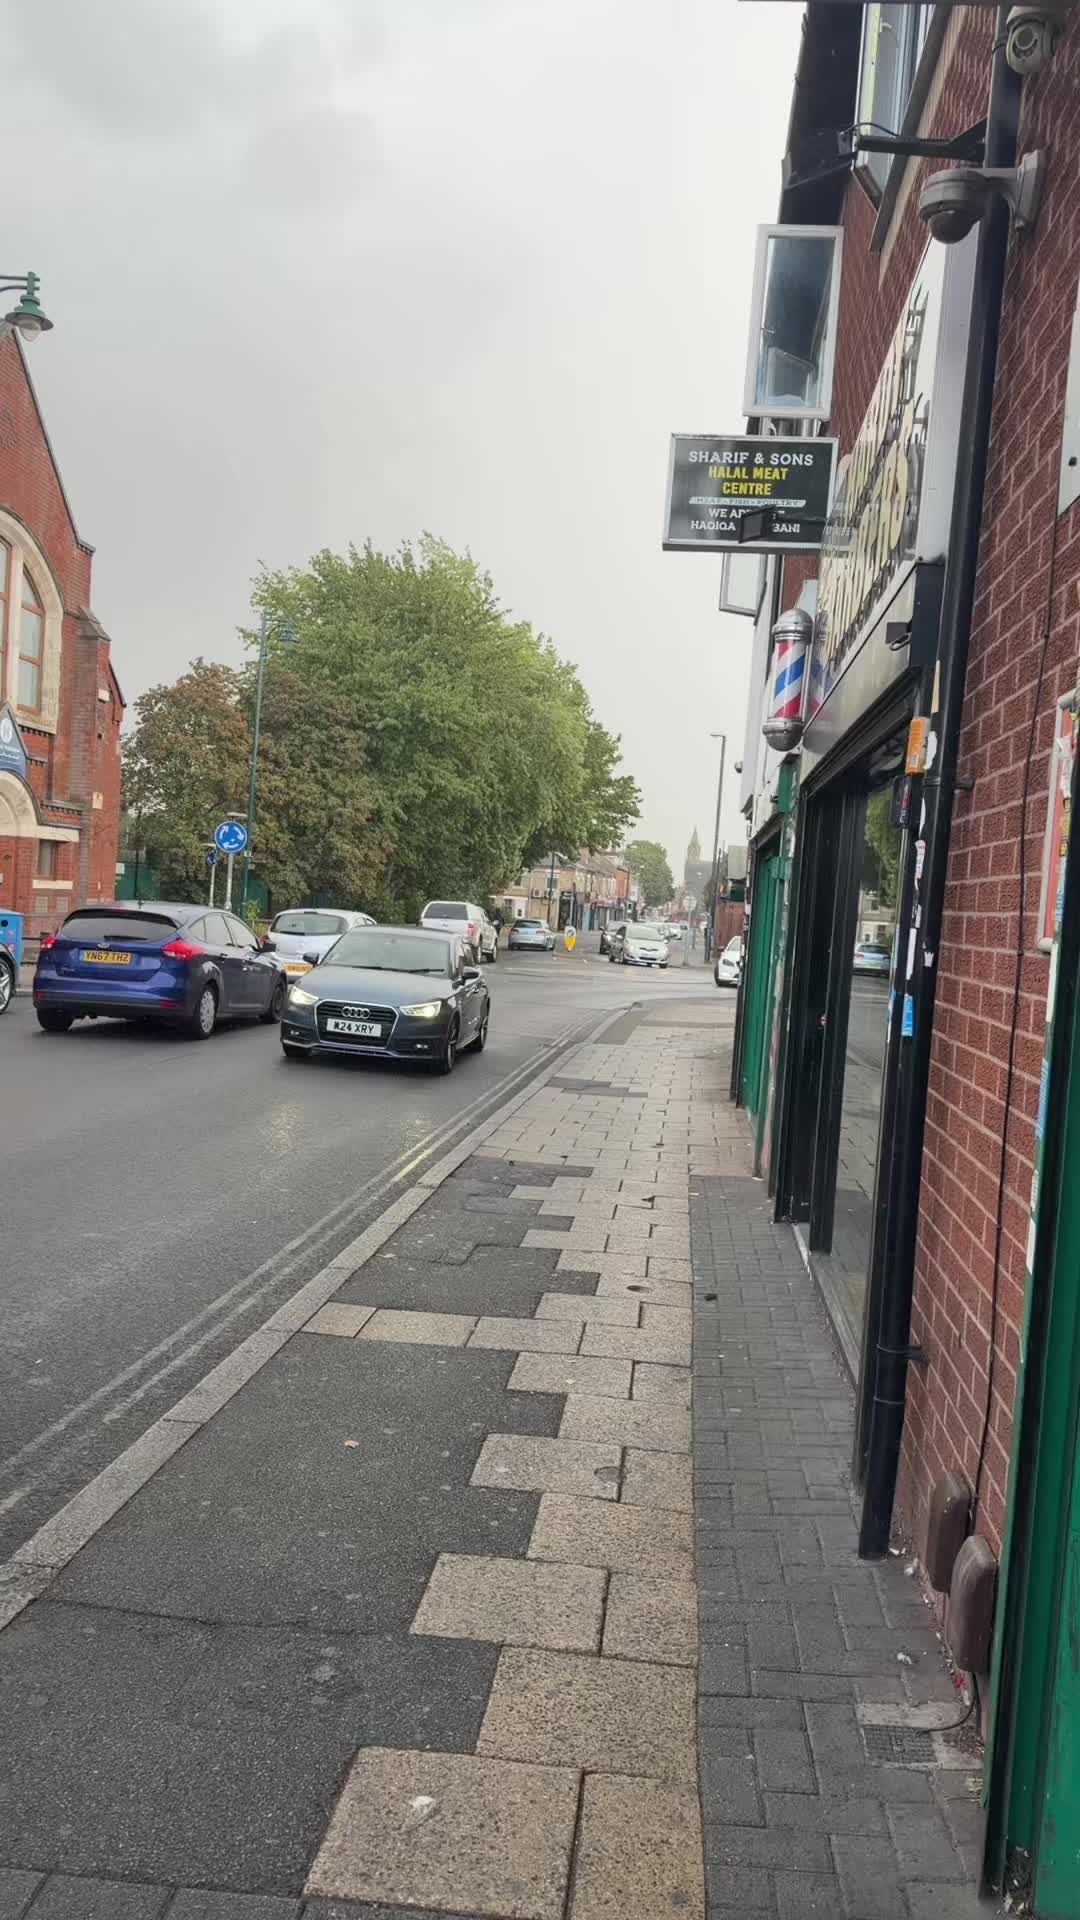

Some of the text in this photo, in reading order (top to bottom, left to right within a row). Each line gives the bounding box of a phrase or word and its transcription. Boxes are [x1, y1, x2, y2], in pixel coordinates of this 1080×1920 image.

[688, 450, 814, 466] SHARIF & SONS
[708, 466, 788, 480] HALAL MEAT
[722, 482, 772, 495] CENTRE
[708, 509, 728, 519] WE
[86, 952, 109, 960] YN67
[354, 1024, 374, 1034] XRY
